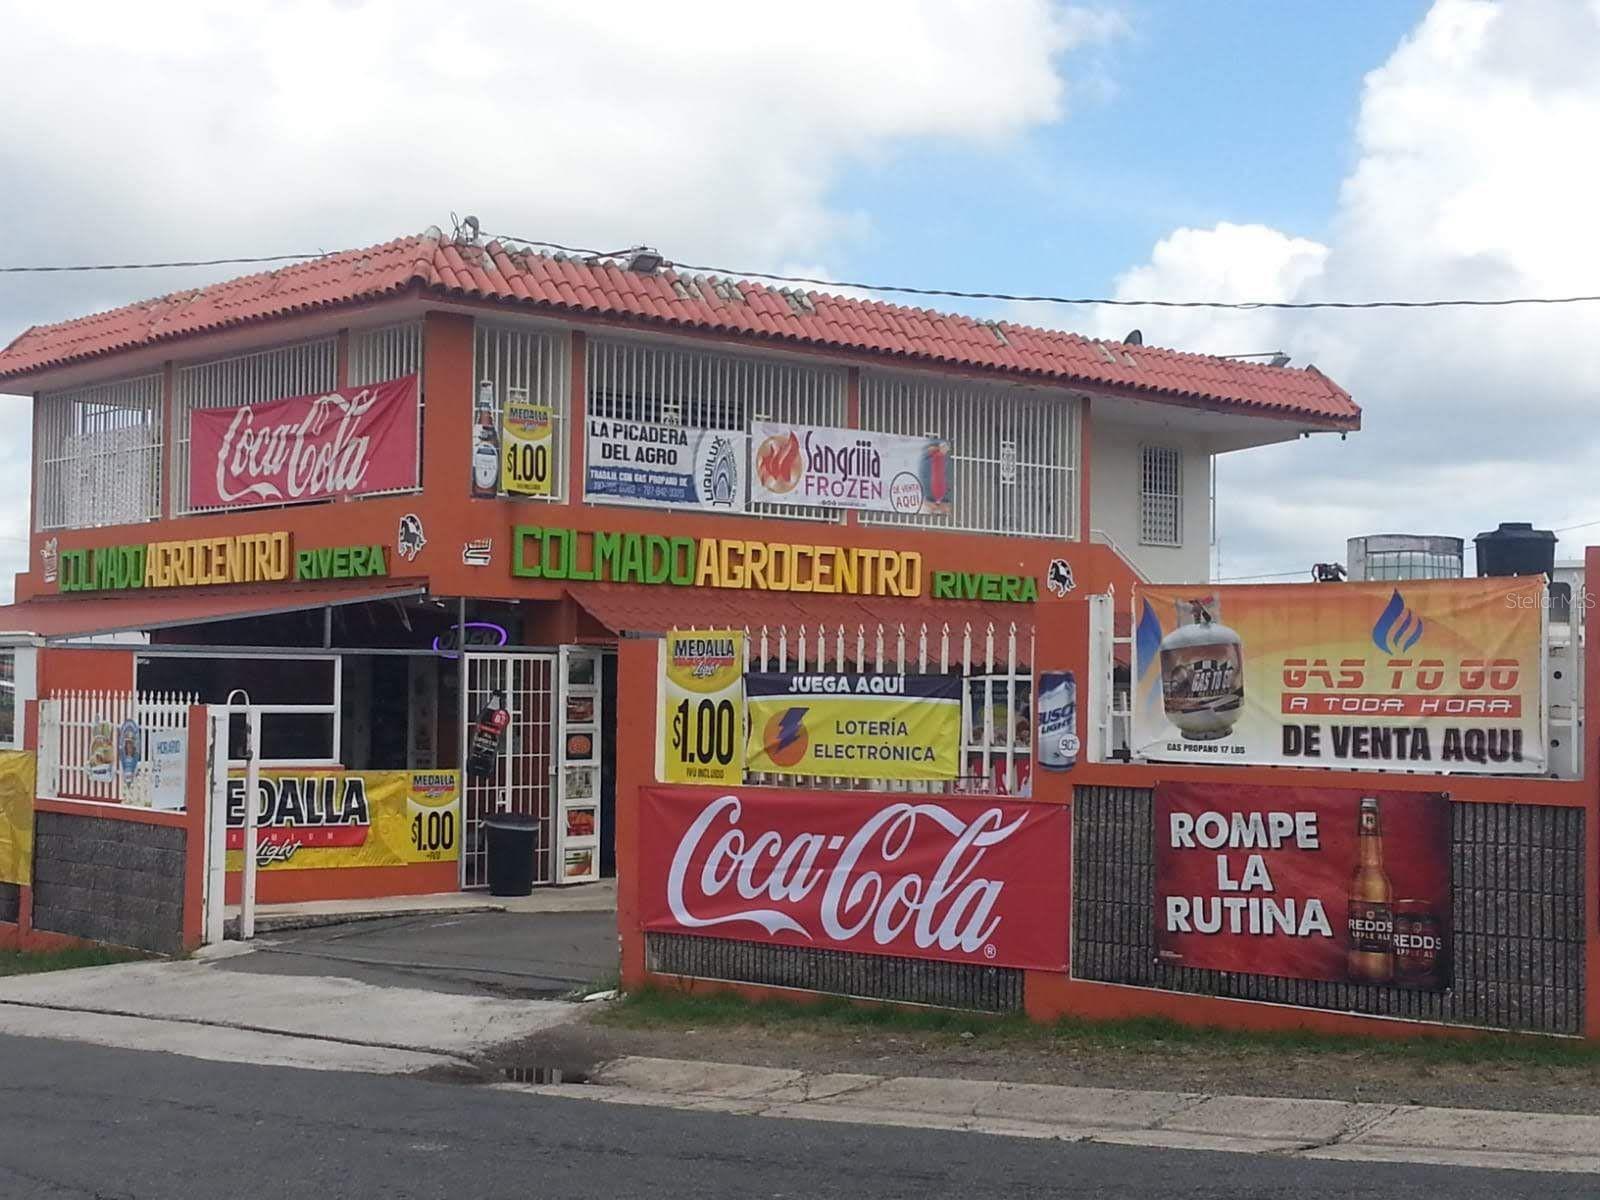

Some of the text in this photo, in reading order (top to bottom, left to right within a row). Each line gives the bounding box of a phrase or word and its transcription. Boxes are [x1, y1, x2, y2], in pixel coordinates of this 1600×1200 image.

[511, 407, 548, 420] MEDALLA
[216, 388, 378, 500] Coca-Cola
[591, 421, 688, 446] LA PICADERA
[507, 443, 547, 482] $1.00
[602, 443, 678, 465] DEL AGRO
[703, 435, 726, 501] LIQUILUX
[805, 475, 882, 499] FROZEN
[896, 496, 919, 508] AQUI
[60, 531, 387, 592] COLMADO AGROCENTRO RIVERA
[513, 525, 1038, 603] COLMADO AGROCENTRO RIVERA
[675, 640, 735, 656] MEDALLA
[789, 677, 850, 693] JUEGA
[1283, 658, 1521, 690] GAS TO GO
[1290, 697, 1512, 713] A TODA HORA
[673, 698, 735, 765] $1.00
[836, 717, 909, 736] LOTERÍA
[1283, 725, 1523, 763] DE VENTA AQUI
[814, 742, 936, 762] ELECTRÓNICA
[1167, 743, 1182, 752] GAS
[1184, 744, 1219, 753] PROPANO
[414, 775, 455, 786] MEDALLA
[226, 778, 371, 828] EDALLA
[411, 811, 454, 851] $1.00
[1170, 811, 1319, 850] ROMPE
[667, 795, 1029, 954] Coca-Cola
[1217, 854, 1274, 892] LA
[1166, 896, 1333, 937] RUTINA
